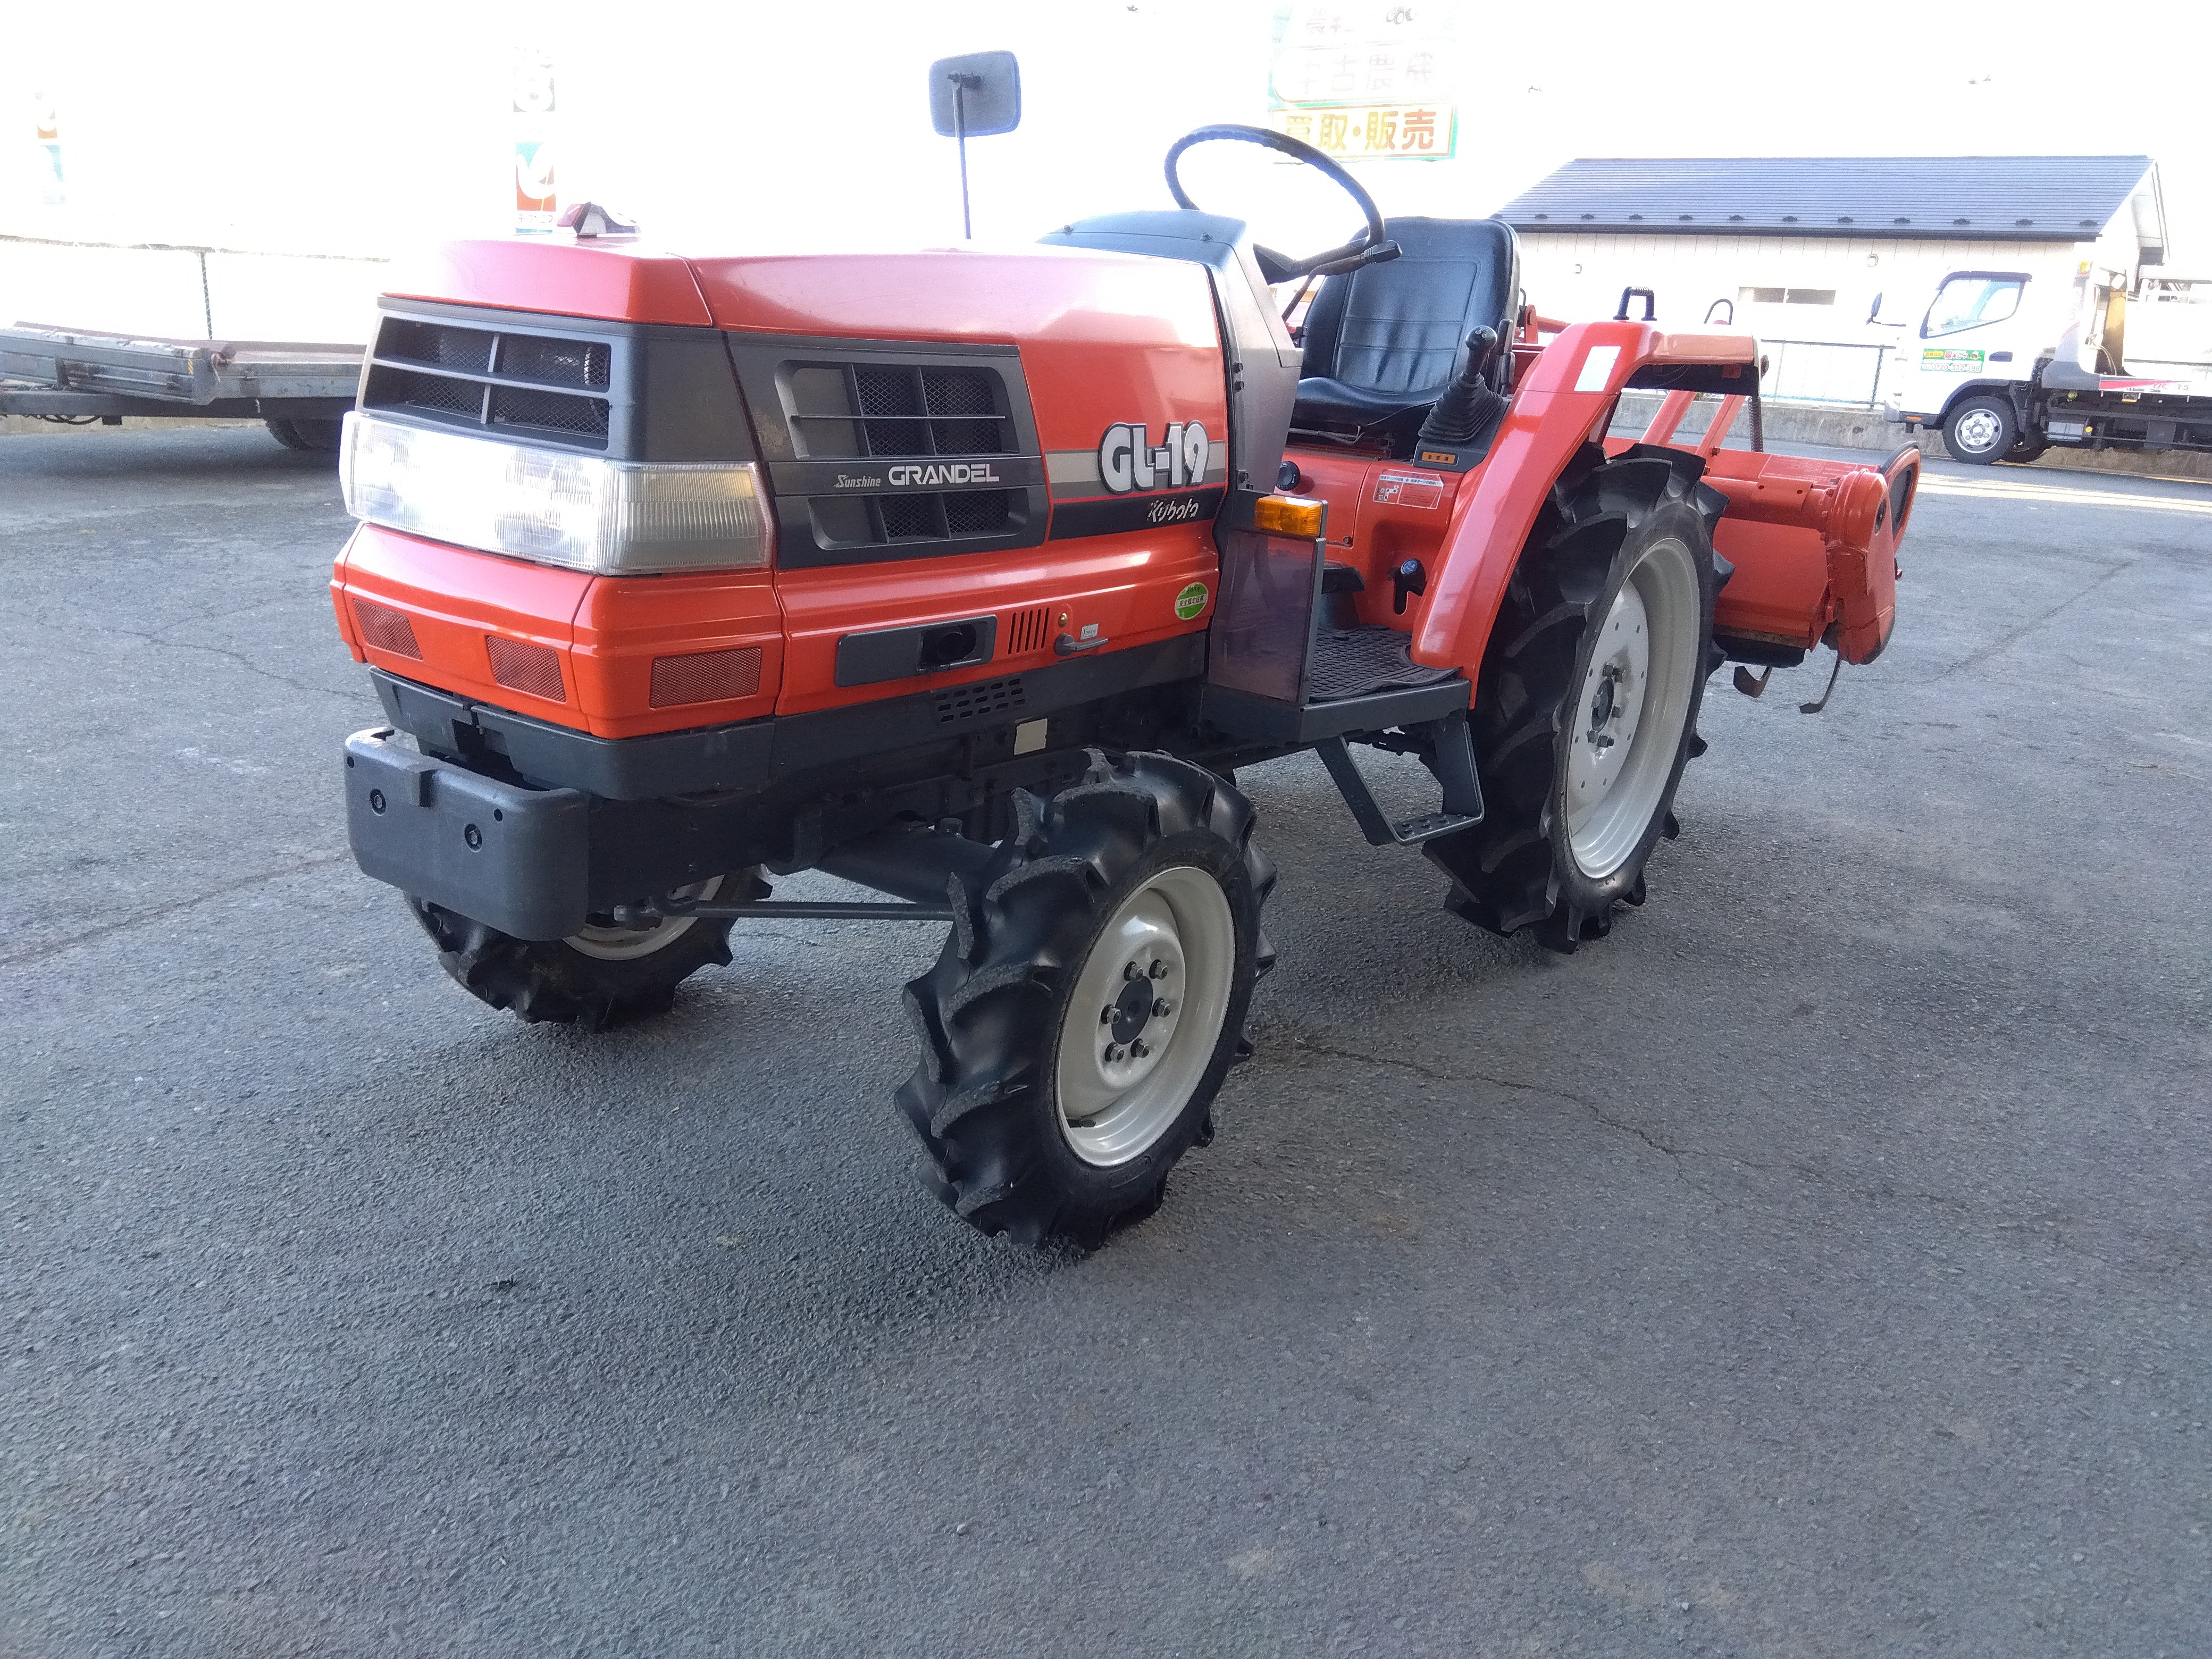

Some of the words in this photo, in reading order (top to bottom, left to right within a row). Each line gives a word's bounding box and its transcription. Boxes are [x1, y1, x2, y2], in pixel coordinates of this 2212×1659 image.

[1098, 420, 1209, 495] GL-19
[833, 474, 881, 488] Sunshine
[888, 464, 1000, 485] GRANDEL
[1147, 498, 1199, 522] Kubota
